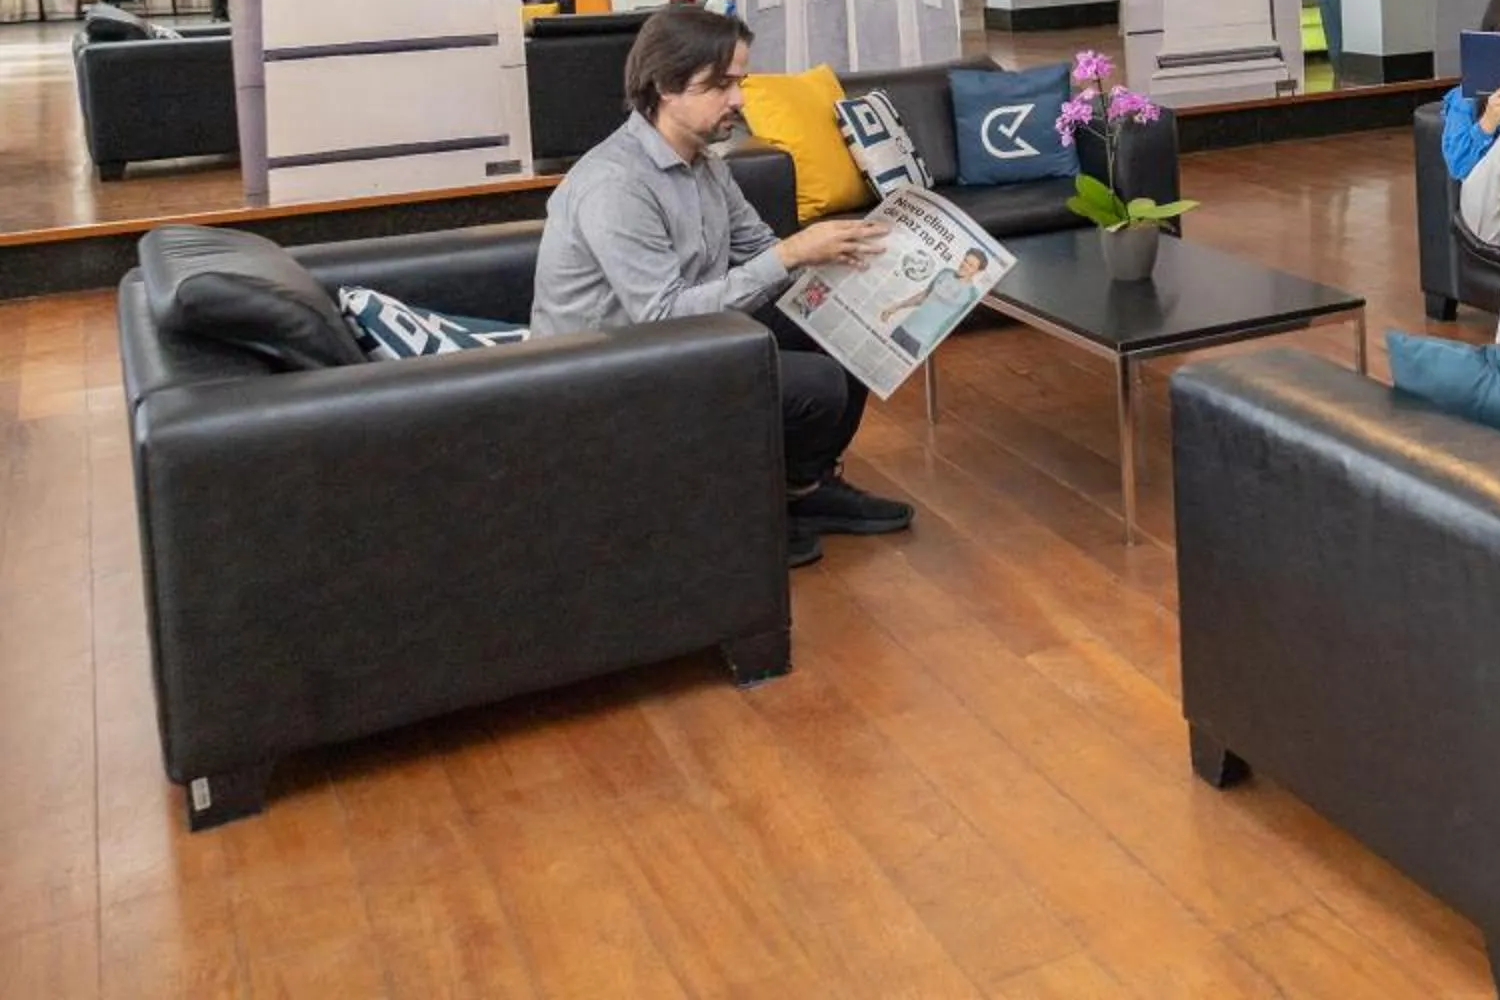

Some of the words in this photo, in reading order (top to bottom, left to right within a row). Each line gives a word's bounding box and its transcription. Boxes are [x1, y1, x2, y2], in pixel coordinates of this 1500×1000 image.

[894, 197, 925, 217] Novo
[923, 214, 955, 244] clima
[896, 214, 921, 233] paz
[919, 230, 936, 247] no
[933, 241, 953, 262] Fla
